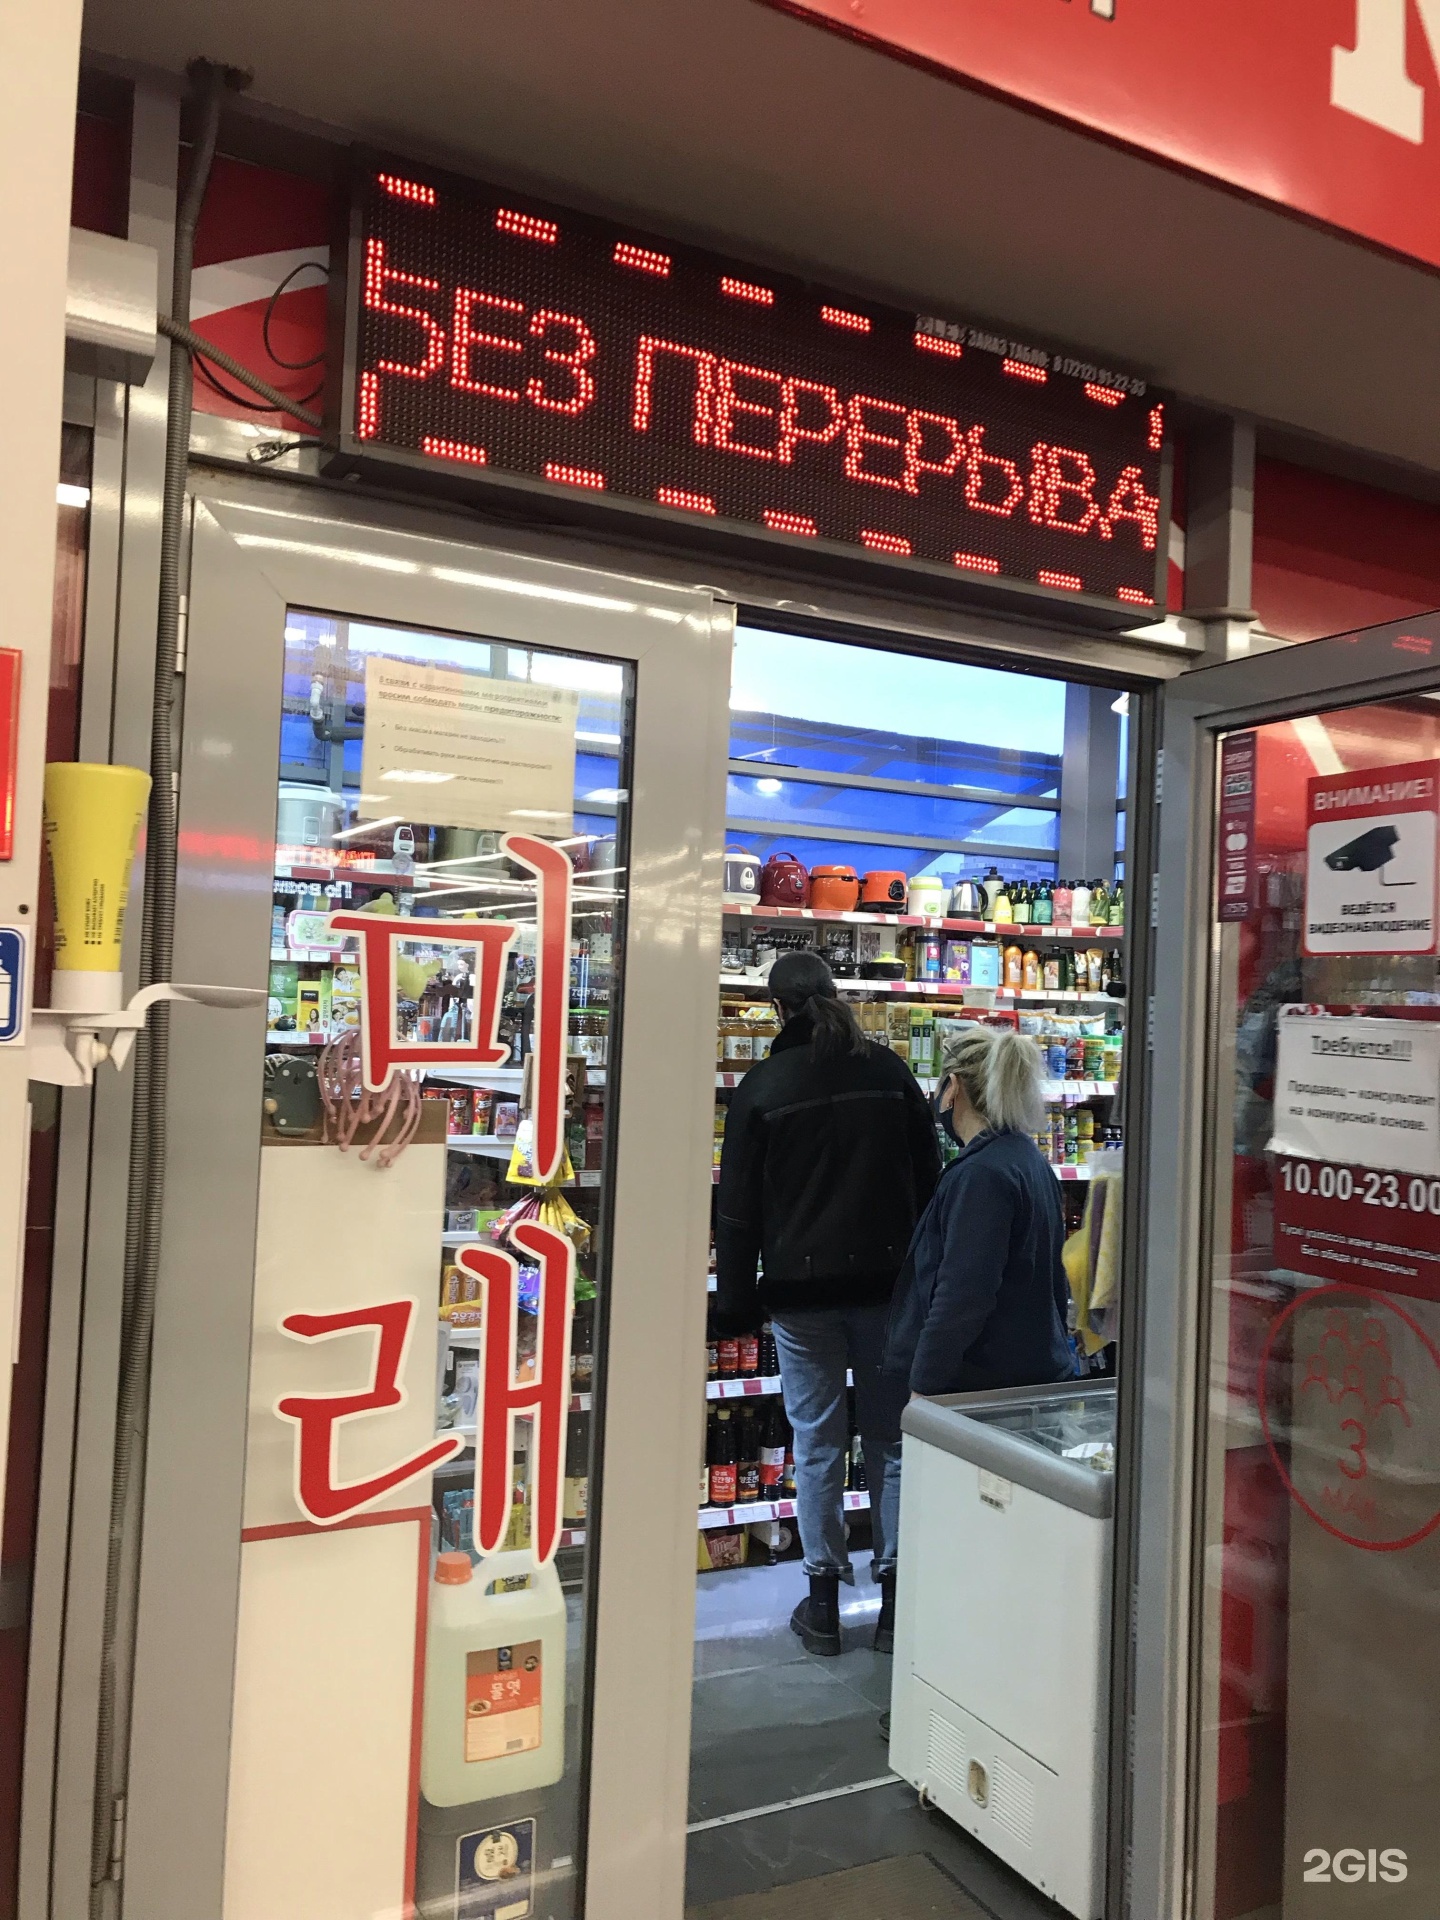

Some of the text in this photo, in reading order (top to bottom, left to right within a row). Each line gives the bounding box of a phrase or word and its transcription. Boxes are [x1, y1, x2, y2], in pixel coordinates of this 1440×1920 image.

[632, 333, 1161, 551] ПЕРЕРЫВА
[378, 690, 411, 701] просим
[1313, 777, 1434, 811] ВНИМАНИЕ!
[1341, 900, 1397, 916] ВЕДЁТСЯ
[1309, 919, 1432, 935] ВИДЕОНАБЛЮДЕНИЕ
[1287, 1079, 1348, 1099] Продавец
[1358, 1089, 1436, 1106] консультант
[1289, 1106, 1304, 1116] на
[1307, 1107, 1378, 1124] конкурсной
[1279, 1161, 1440, 1216] 10.00-23.00
[1337, 1418, 1368, 1480] 3
